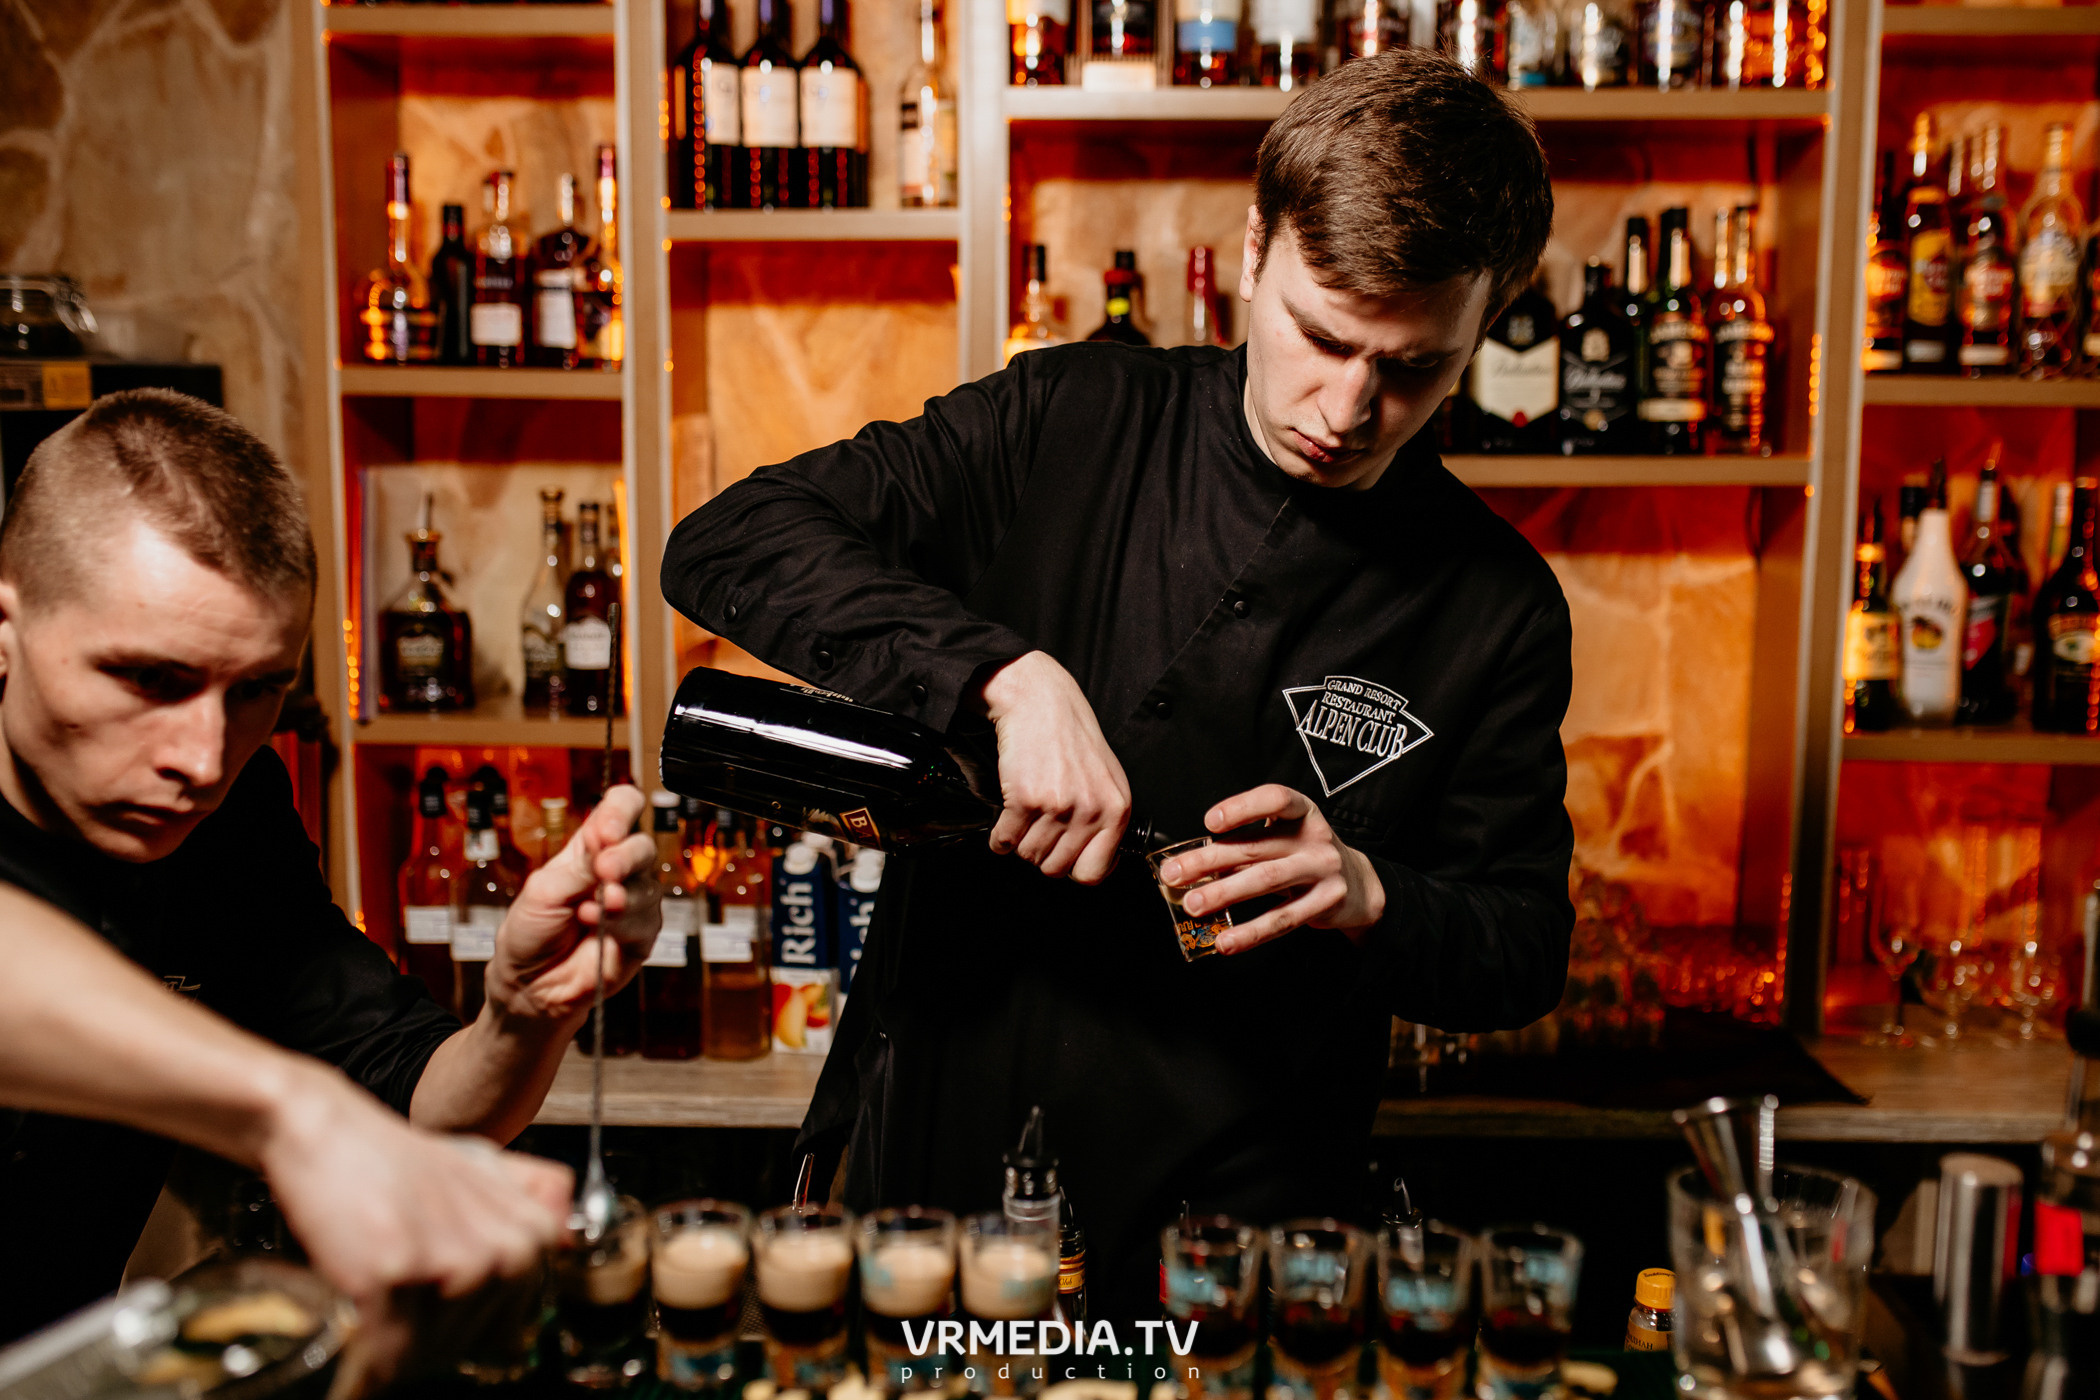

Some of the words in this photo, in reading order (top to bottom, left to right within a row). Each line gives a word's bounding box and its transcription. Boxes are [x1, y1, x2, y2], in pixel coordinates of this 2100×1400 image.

[1321, 691, 1396, 724] RESTAURANT
[1327, 680, 1363, 695] GRAND
[1364, 688, 1401, 711] RESORT
[1296, 699, 1361, 747] ALPEN
[1356, 721, 1408, 760] CLUB
[780, 881, 816, 964] Rich
